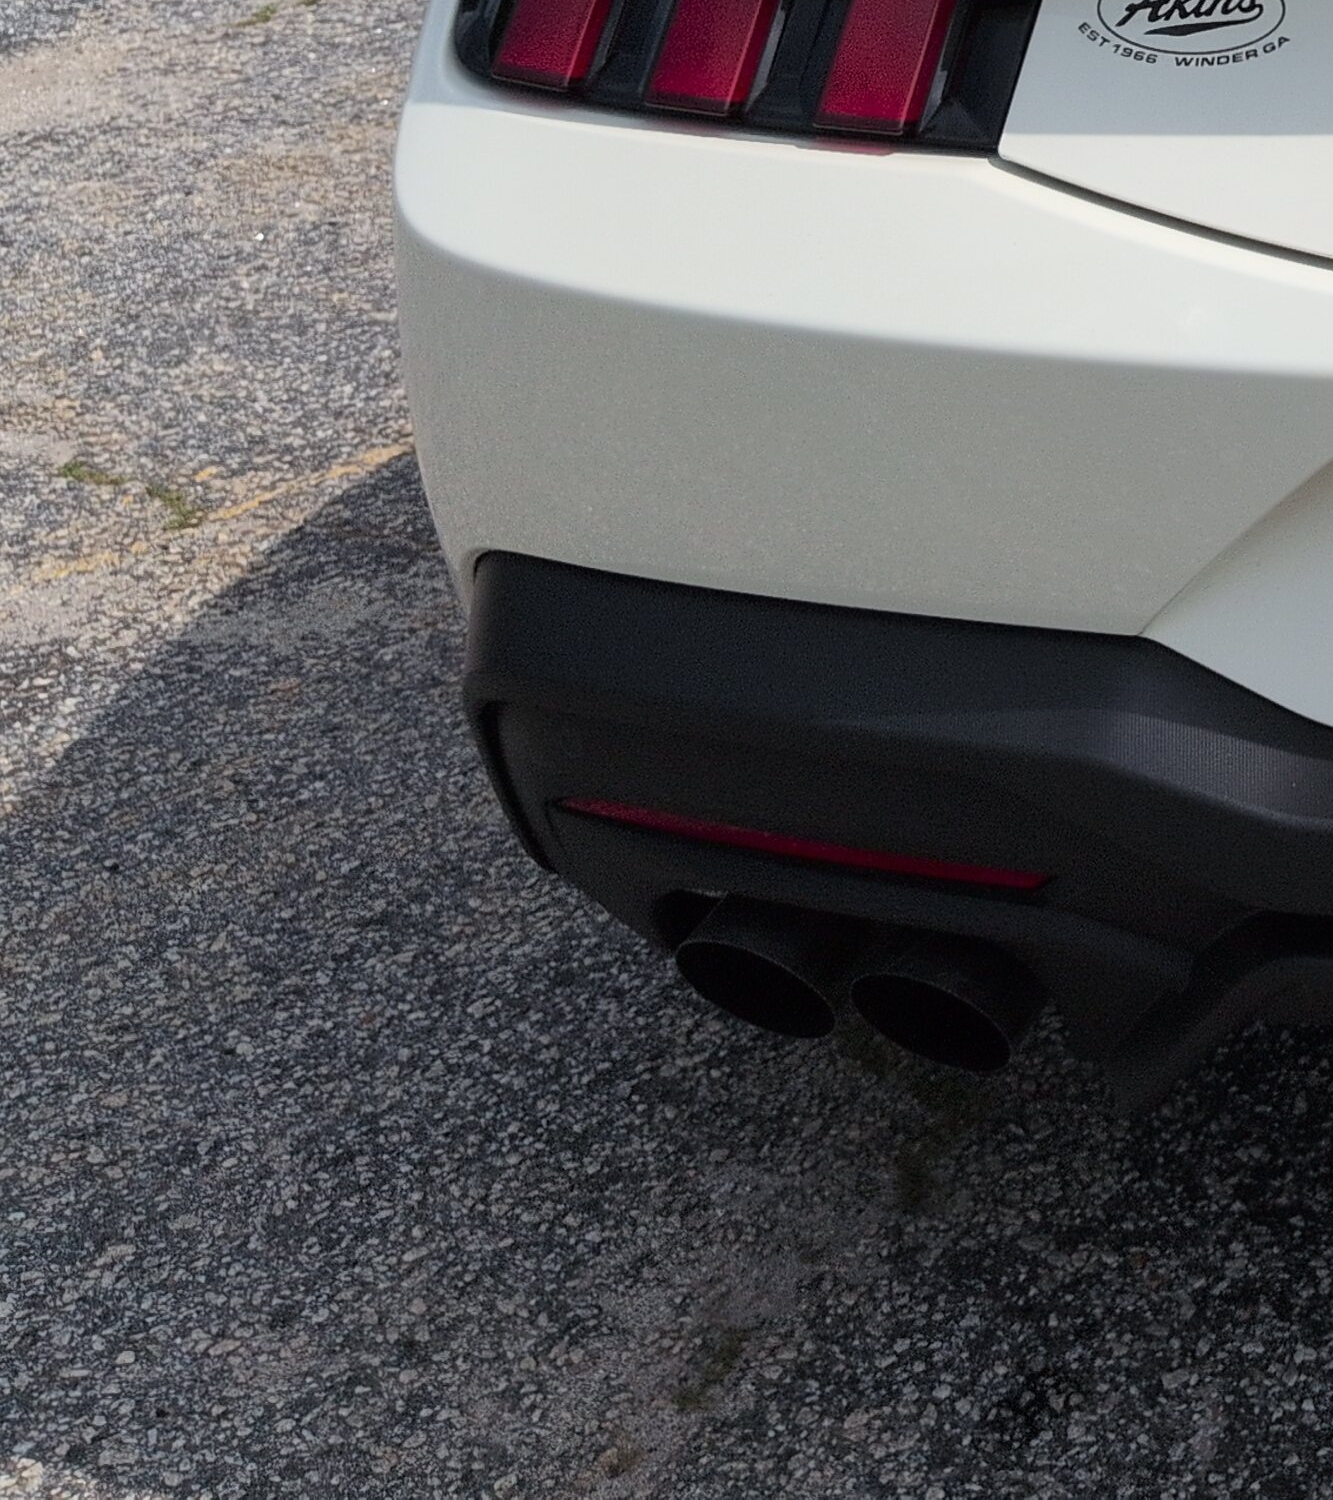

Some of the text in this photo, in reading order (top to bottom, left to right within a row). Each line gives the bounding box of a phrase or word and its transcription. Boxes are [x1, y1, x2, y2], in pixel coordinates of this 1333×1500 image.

[1078, 22, 1290, 67] EST 1966 WINDER GA
